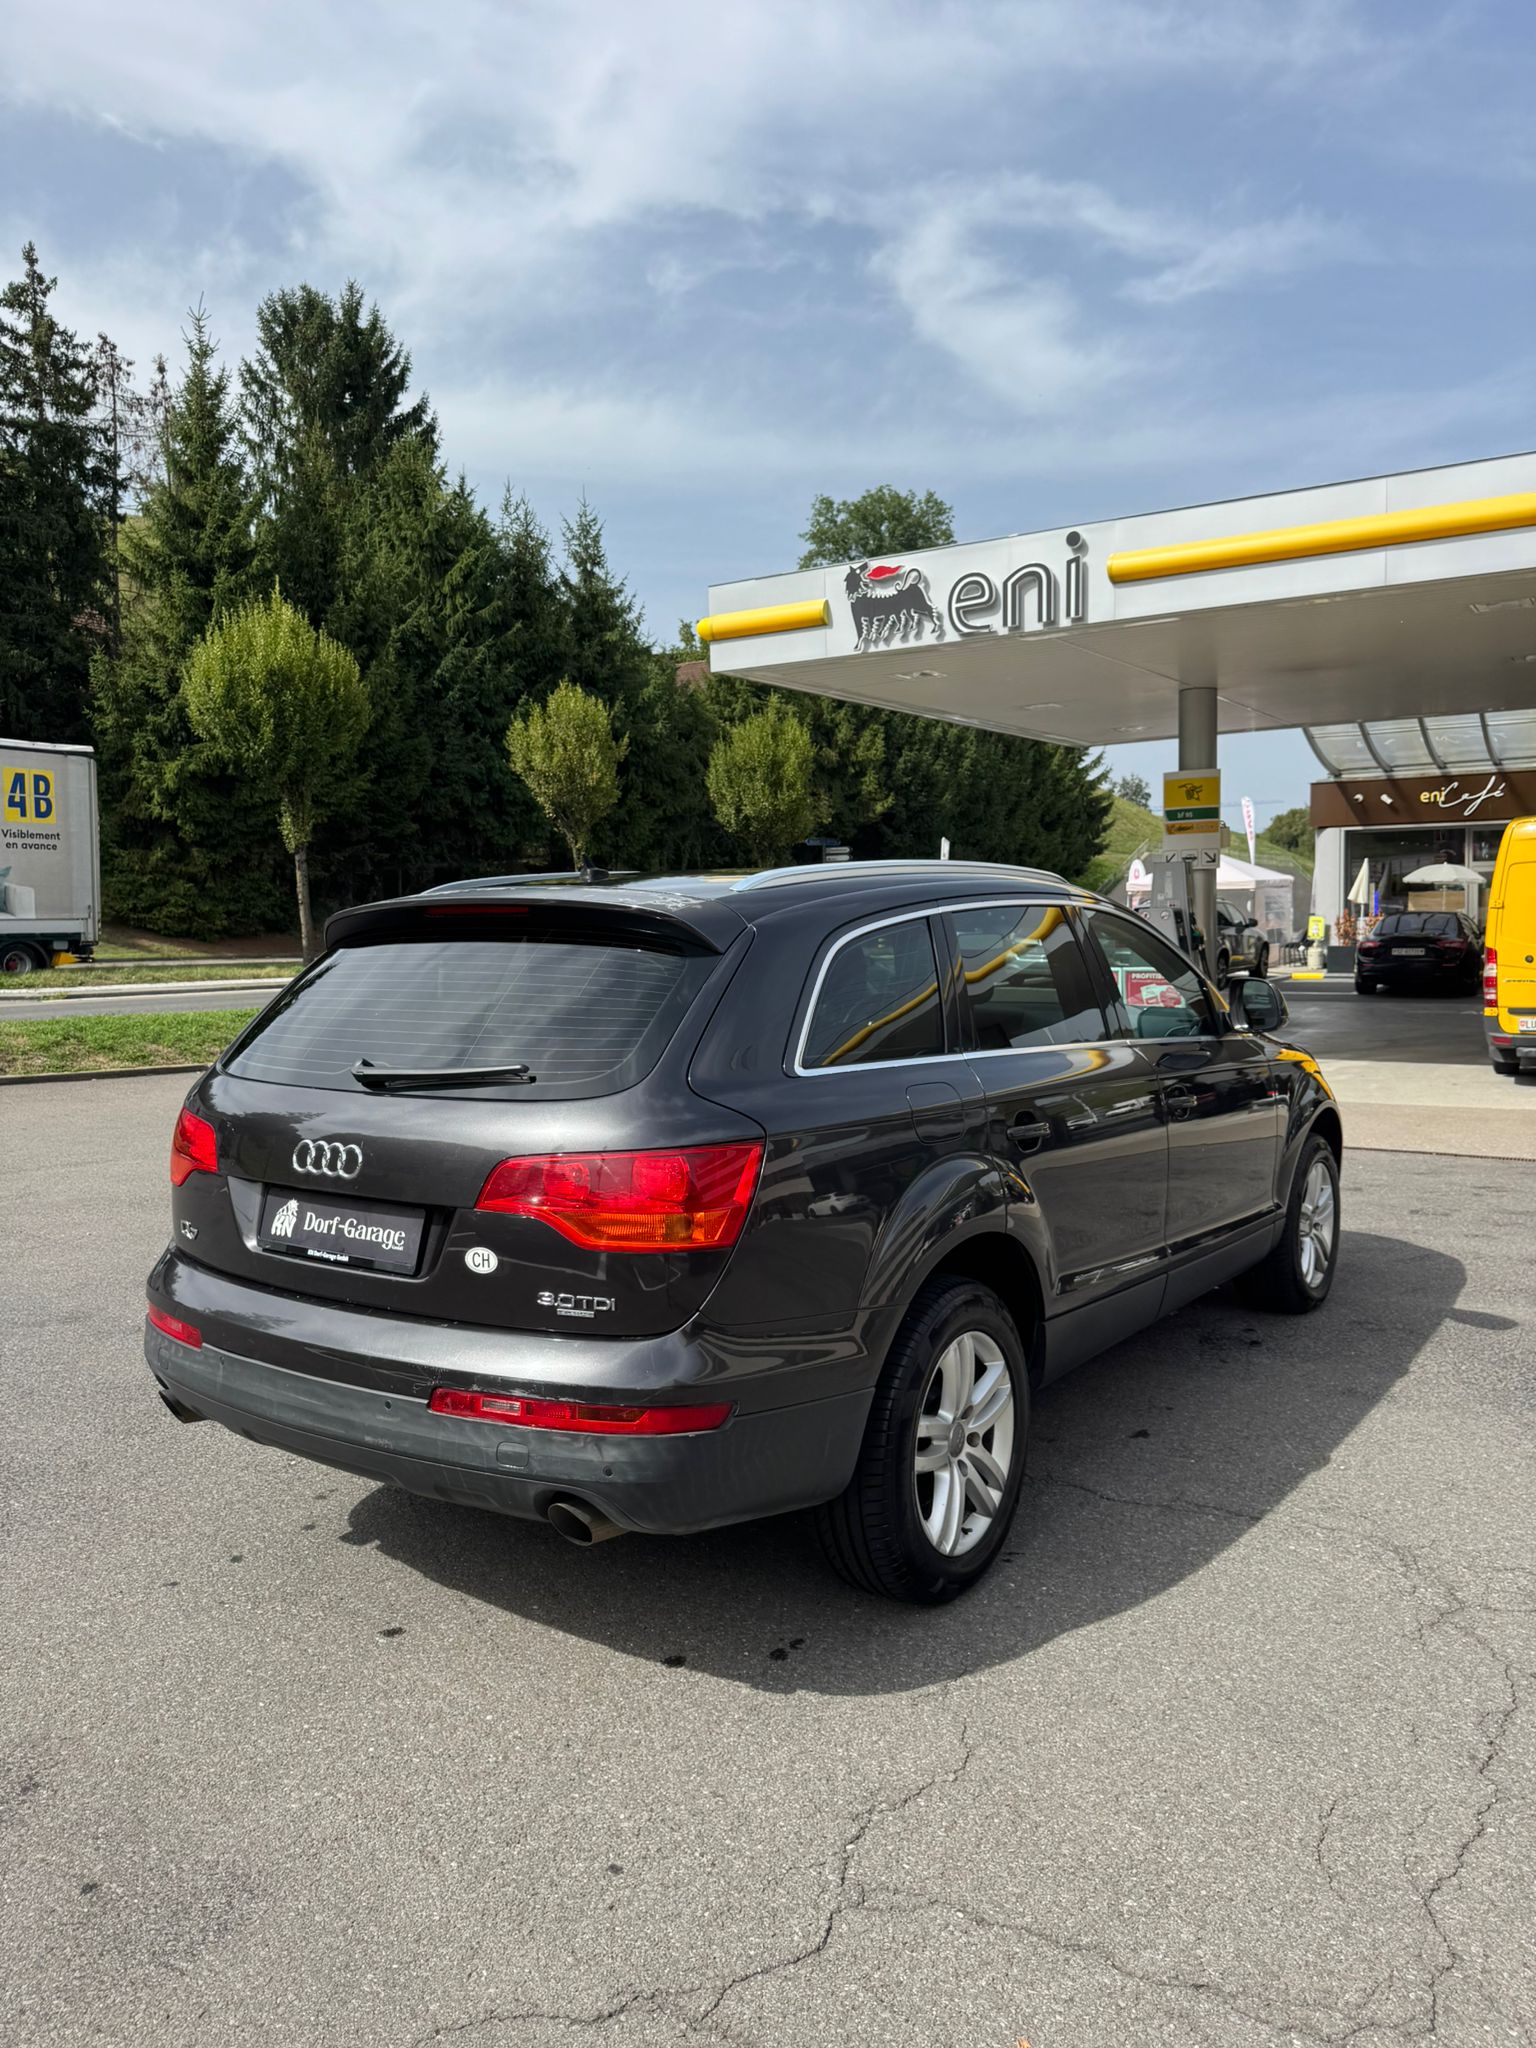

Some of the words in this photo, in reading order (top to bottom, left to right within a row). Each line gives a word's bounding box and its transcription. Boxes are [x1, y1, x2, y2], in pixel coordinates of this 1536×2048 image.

[948, 530, 1084, 633] eni
[8, 772, 53, 818] 4B
[1, 828, 61, 841] Visiblement
[6, 842, 18, 850] en
[22, 842, 57, 851] avance
[303, 1211, 407, 1251] Dorf-Garage
[472, 1251, 491, 1270] CH
